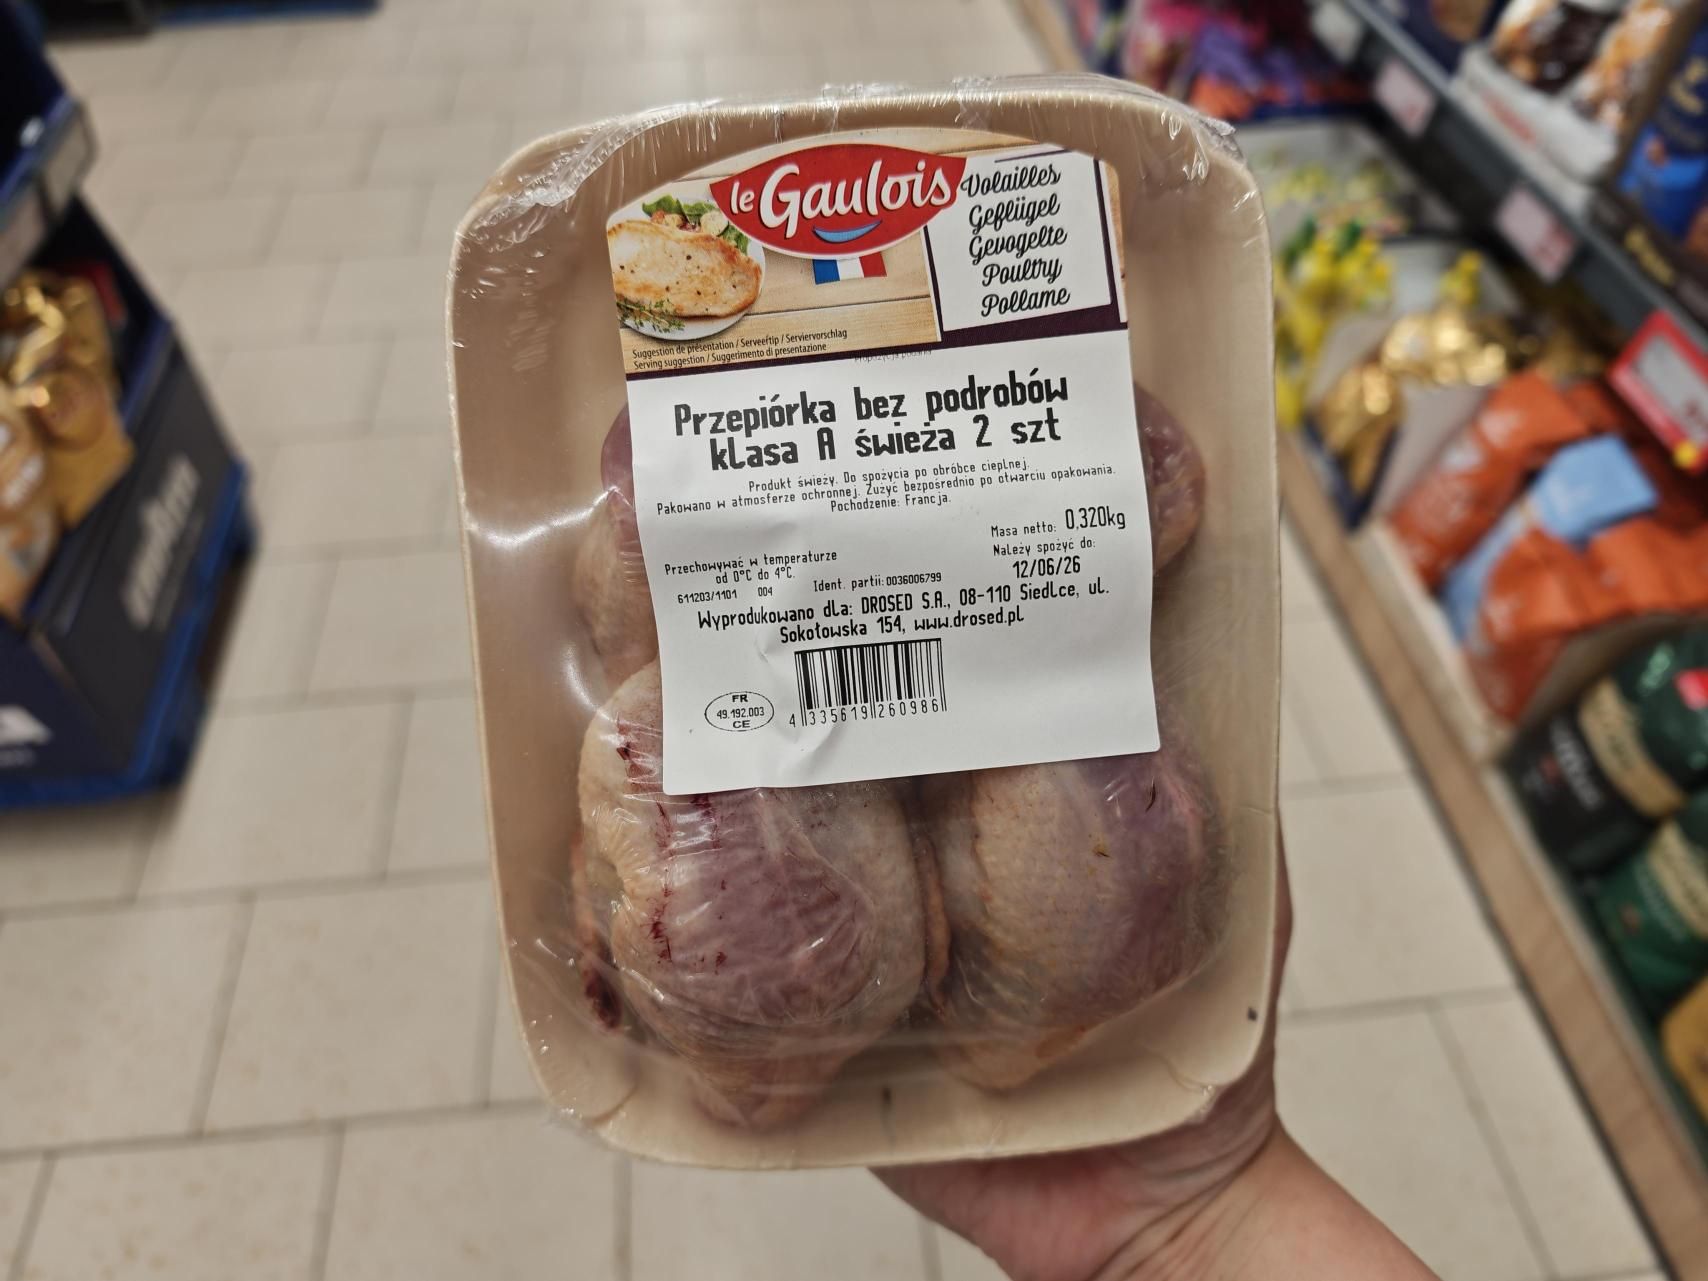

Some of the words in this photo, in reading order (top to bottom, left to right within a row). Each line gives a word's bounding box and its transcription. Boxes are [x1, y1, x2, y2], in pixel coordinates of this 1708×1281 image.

[960, 163, 1061, 198] Volailles
[729, 181, 754, 215] le
[759, 159, 952, 238] Gaulois
[969, 192, 1061, 235] Geflügel
[969, 225, 1068, 265] Gevogelte
[982, 257, 1063, 287] Poultry
[981, 287, 1070, 317] Pollame
[632, 346, 675, 360] Suggestion
[676, 345, 686, 355] de
[687, 340, 734, 356] présentation
[785, 329, 848, 343] Serviervorschlag
[633, 356, 663, 370] Serving
[664, 353, 705, 368] suggestion
[711, 349, 764, 364] Suggerimento
[766, 347, 774, 357] di
[775, 342, 827, 358] presentazione
[674, 390, 837, 438] Przepiórka
[853, 386, 907, 420] bez
[925, 367, 1068, 421] podrobów
[709, 436, 799, 471] klasa
[816, 426, 837, 461] A
[854, 421, 956, 457] świeża
[972, 414, 993, 448] 2
[1010, 407, 1062, 444] szt
[657, 501, 711, 515] Pakowano
[717, 500, 726, 509] w
[732, 492, 796, 508] atmosferze
[801, 484, 861, 502] ochronnej.
[866, 481, 898, 497] Zużyć
[903, 476, 975, 494] bezpośrednio
[980, 477, 993, 489] po
[998, 469, 1046, 486] otwarciu
[1051, 463, 1116, 482] opakowania.
[749, 475, 792, 492] Produkt
[798, 473, 839, 488] świeży.
[843, 471, 857, 483] Do
[862, 466, 910, 483] spożycia
[914, 468, 928, 480] po
[933, 462, 976, 477] obróbce
[981, 458, 1030, 473] cieplnej.
[831, 495, 900, 512] Pochodzenie:
[905, 492, 952, 507] Francja.
[991, 525, 1018, 538] Masa
[1023, 521, 1057, 535] netto:
[1065, 506, 1126, 531] 0,320kg
[993, 541, 1031, 557] Należy
[1037, 538, 1075, 553] spożyć
[1080, 536, 1096, 549] do:
[664, 556, 744, 576] Przechowywać
[749, 557, 758, 568] w
[763, 550, 838, 569] temperaturze
[715, 571, 728, 585] od
[733, 569, 753, 583] 0°C
[757, 568, 770, 581] do
[1012, 555, 1082, 579] 12/06/26
[677, 589, 738, 605] 611203/1101
[757, 586, 773, 597] 004
[813, 577, 846, 593] Ident.
[697, 605, 815, 631] Wyprodukowano
[823, 599, 853, 618] dla:
[861, 593, 914, 615] DROSED
[921, 590, 951, 611] S.A.,
[959, 585, 1012, 606] 08-110
[1020, 580, 1080, 601] Siedlce,
[1088, 577, 1110, 596] ul.
[780, 618, 868, 644] Sokołowska
[876, 614, 906, 635] 154,
[914, 605, 1025, 631] www.drosed.pl
[716, 706, 765, 720] 49.192.003
[731, 694, 749, 704] FR
[732, 719, 750, 729] CE
[789, 713, 797, 728] 4
